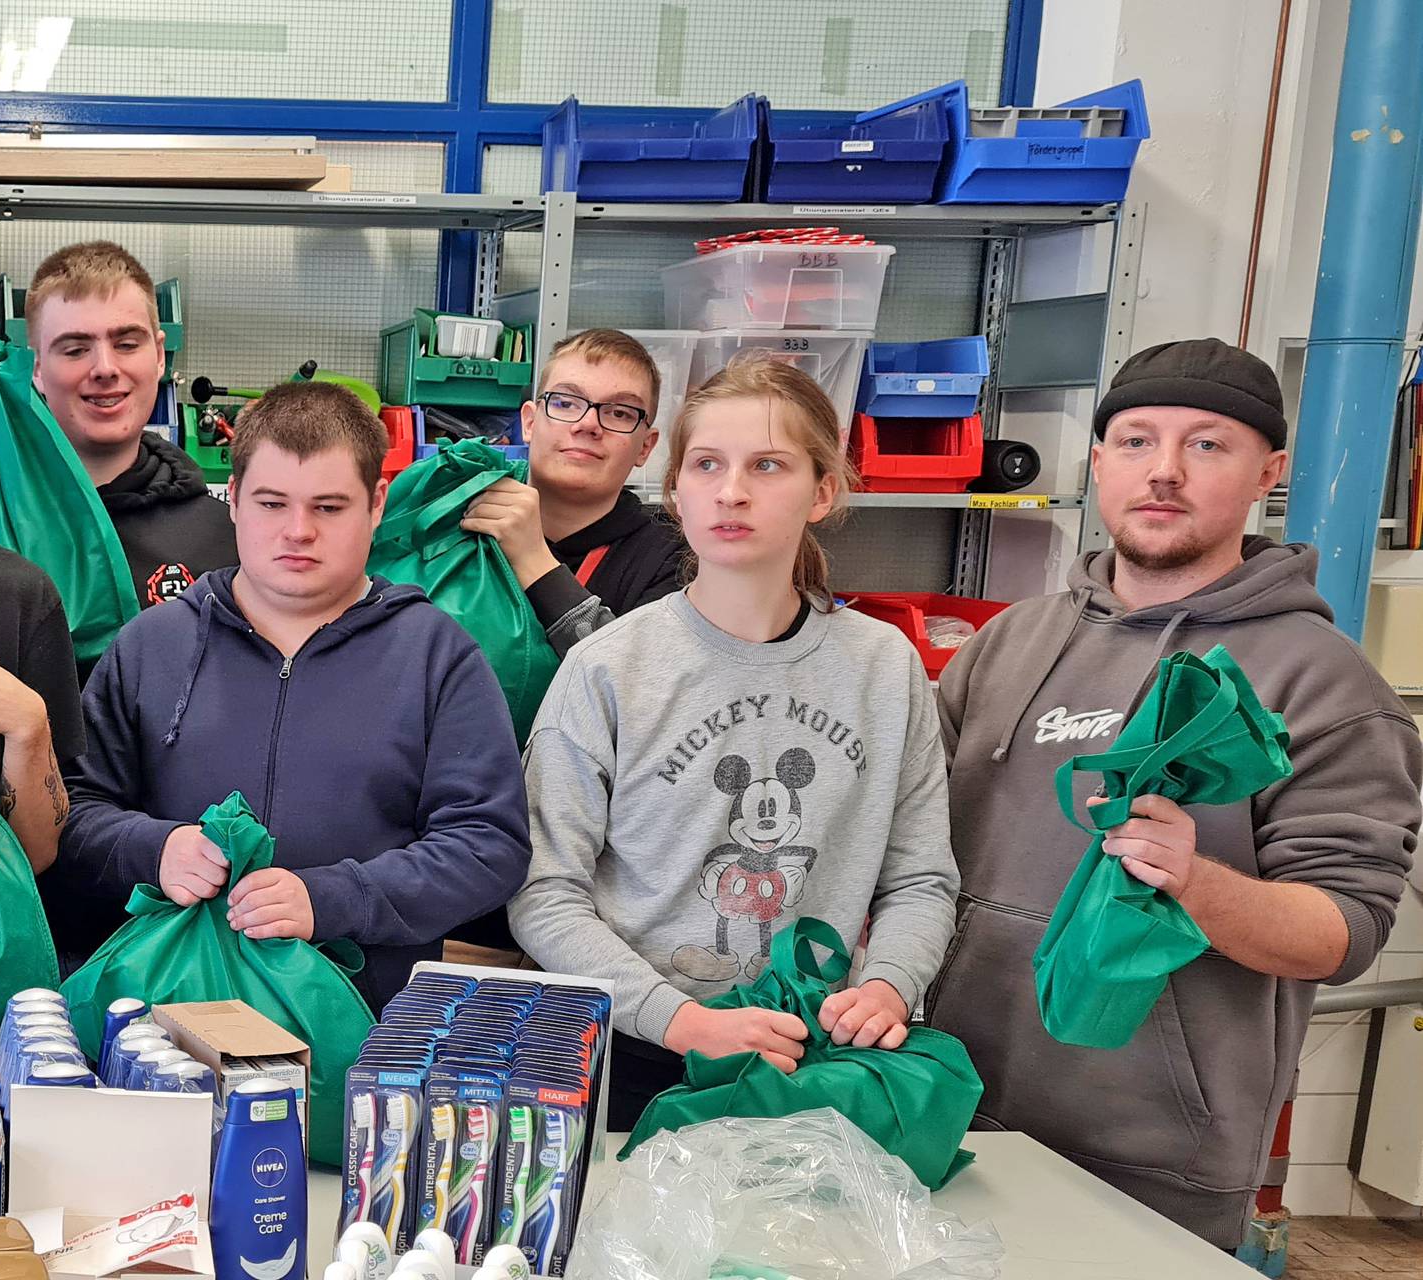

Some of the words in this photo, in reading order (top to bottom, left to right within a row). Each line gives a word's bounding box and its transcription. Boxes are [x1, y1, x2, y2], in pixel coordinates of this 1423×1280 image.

[797, 252, 838, 267] BBB
[658, 694, 771, 786] MICKEY
[384, 1075, 415, 1083] WEICH
[464, 1089, 498, 1097] MITTEL
[544, 1092, 570, 1102] HART
[349, 1121, 358, 1148] CARE
[257, 1162, 284, 1173] NIVEA
[348, 1148, 358, 1186] CLASSIC
[425, 1140, 436, 1199] INTERDENTAL
[504, 1143, 516, 1204] INTERDENTAL
[268, 1195, 286, 1203] Shower
[253, 1211, 287, 1224] Creme
[259, 1223, 283, 1234] Care
